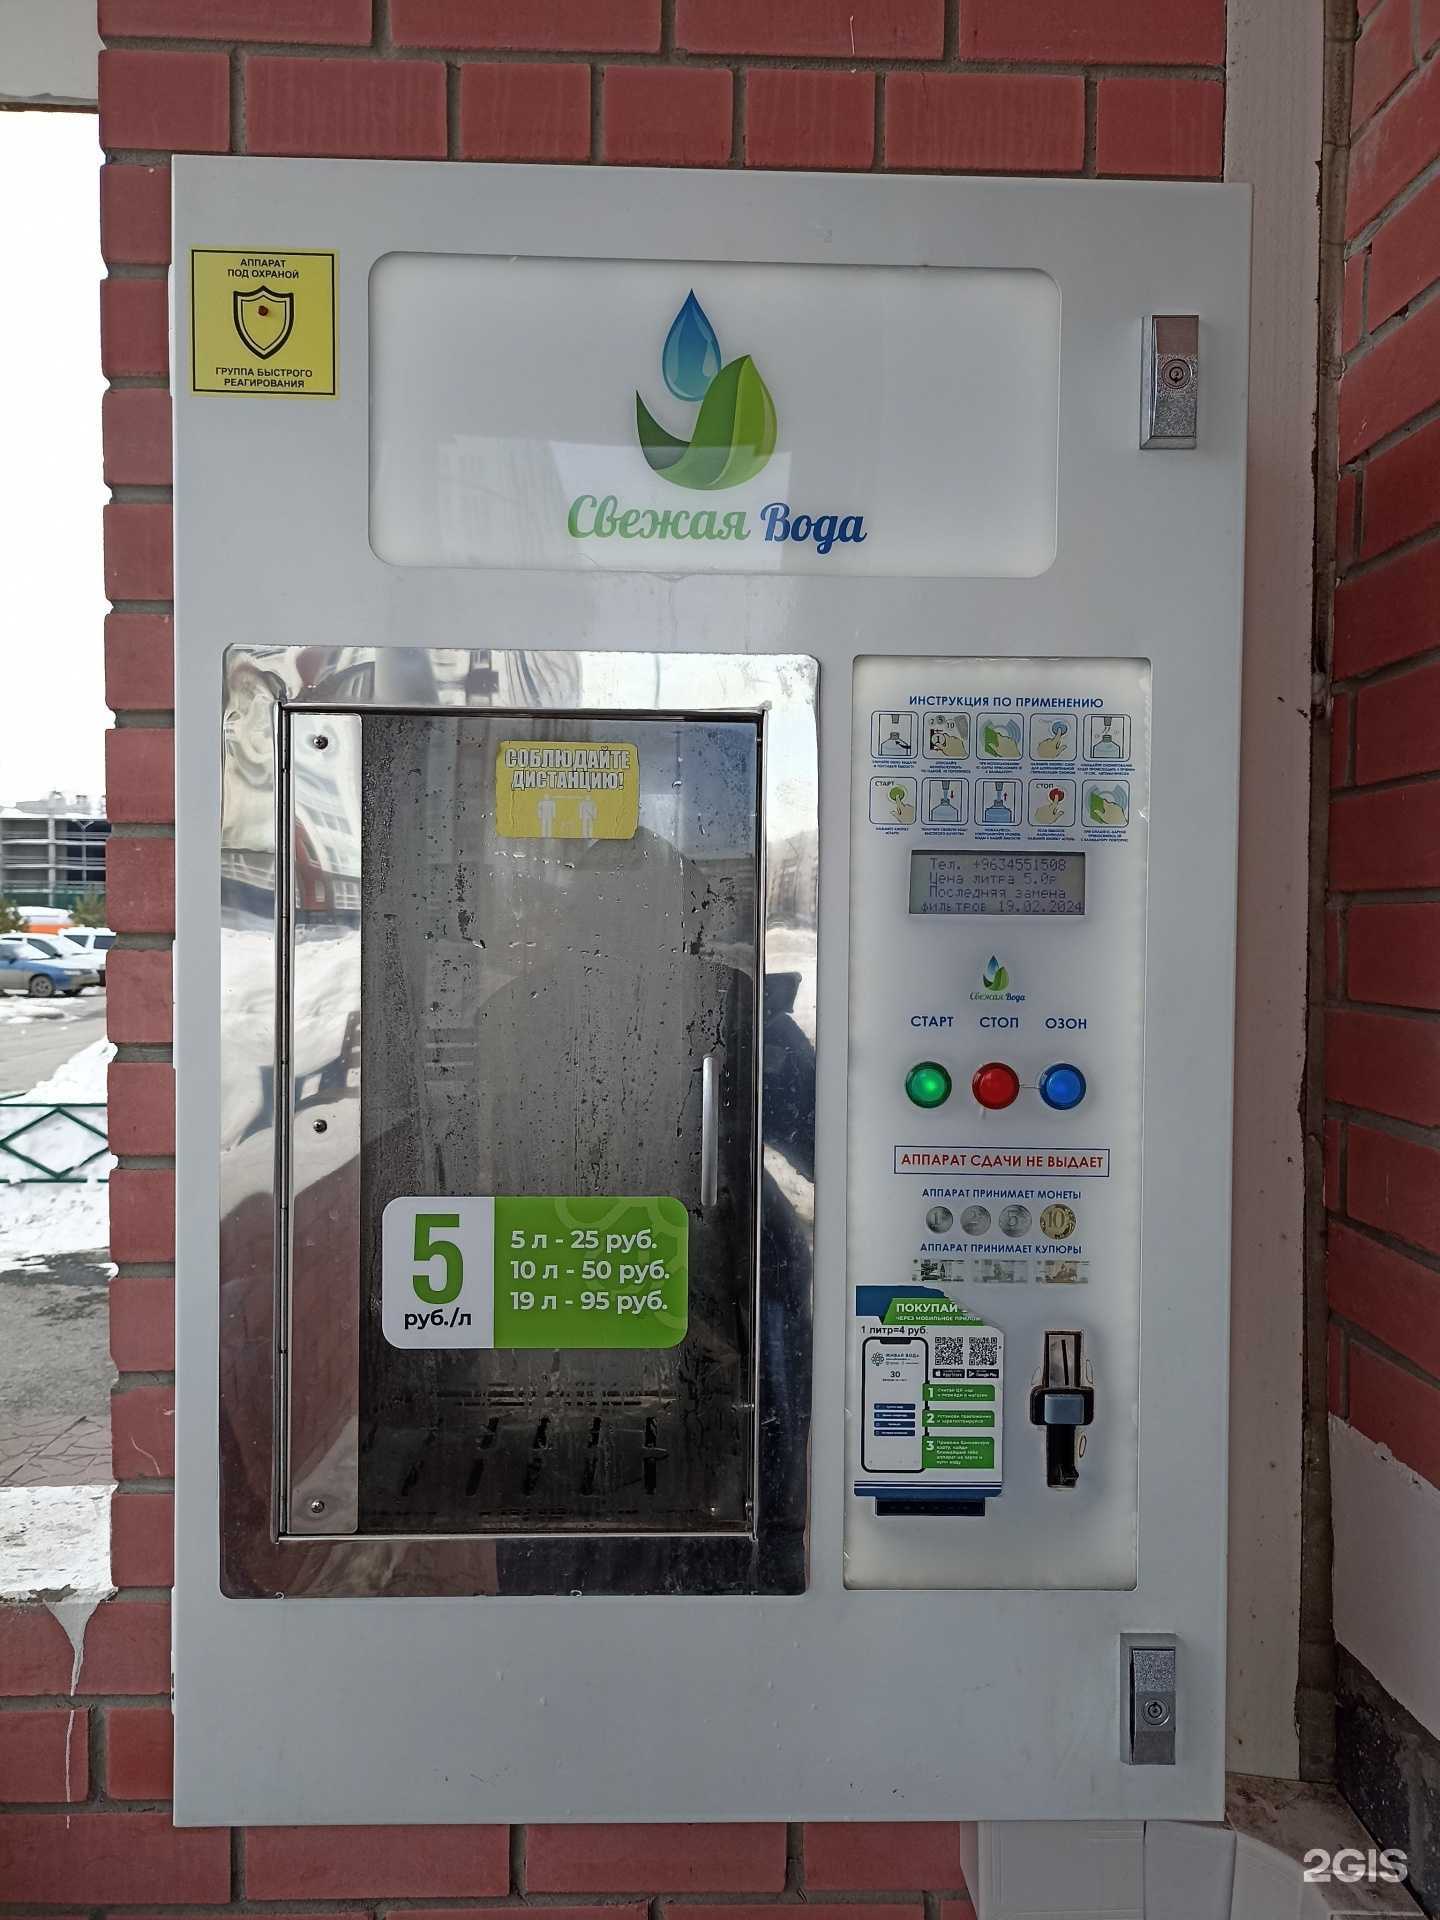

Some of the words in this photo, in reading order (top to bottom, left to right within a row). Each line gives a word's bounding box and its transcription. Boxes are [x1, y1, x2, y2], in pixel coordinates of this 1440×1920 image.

[240, 258, 286, 268] АППАРАТ
[227, 268, 250, 279] ПОД
[251, 269, 299, 279] ОХРАНОЙ
[215, 367, 254, 377] ГРУППА
[257, 368, 313, 378] БЫСТРОГО
[224, 378, 305, 388] РЕАГИРОВАНИЯ
[567, 494, 751, 540] Свежая
[760, 502, 868, 555] Вода
[909, 695, 989, 708] ИНСТРУКЦИЯ
[993, 696, 1011, 708] ПО
[1015, 697, 1104, 709] ПРИМЕНЕНИЮ
[505, 746, 630, 771] СОБЛЮДАЙТЕ
[511, 770, 625, 792] ДИСТАНЦИЮ!
[930, 857, 961, 871] Тел.
[929, 872, 964, 885] Цена
[973, 874, 1015, 885] литра
[929, 885, 1007, 899] Последняя
[1015, 889, 1066, 899] замена
[1000, 900, 1082, 913] 19.02.2024
[1005, 992, 1026, 1003] Вода
[910, 1015, 954, 1027] СТАРТ
[979, 1016, 1019, 1028] СТОП
[1045, 1017, 1087, 1029] ОЗОН
[901, 1154, 967, 1166] АППАРАТ
[970, 1154, 1021, 1168] СДАЧИ
[1026, 1156, 1043, 1167] НЕ
[1047, 1156, 1103, 1169] ВЫДАЕТ
[922, 1188, 970, 1198] АППАРАТ
[973, 1189, 1034, 1199] ПРИНИМАЕТ
[1037, 1190, 1081, 1199] МОНЕТЫ
[510, 1230, 526, 1249] 5
[531, 1232, 548, 1249] л
[570, 1230, 599, 1249] 25
[606, 1229, 657, 1253] руб.
[920, 1243, 968, 1252] АППАРАТ
[971, 1244, 1032, 1254] ПРИНИМАЕТ
[1035, 1244, 1082, 1255] КУПЮРЫ
[412, 1213, 464, 1304] 5
[510, 1260, 536, 1280] 10
[542, 1262, 559, 1280] л
[582, 1260, 612, 1280] 50
[619, 1259, 670, 1284] руб.
[510, 1291, 535, 1310] 19
[541, 1293, 558, 1310] л
[580, 1291, 610, 1310] 95
[617, 1289, 668, 1315] руб.
[403, 1307, 472, 1330] руб./л
[928, 1387, 934, 1398] 1
[926, 1413, 935, 1423] 2
[926, 1440, 935, 1451] 3
